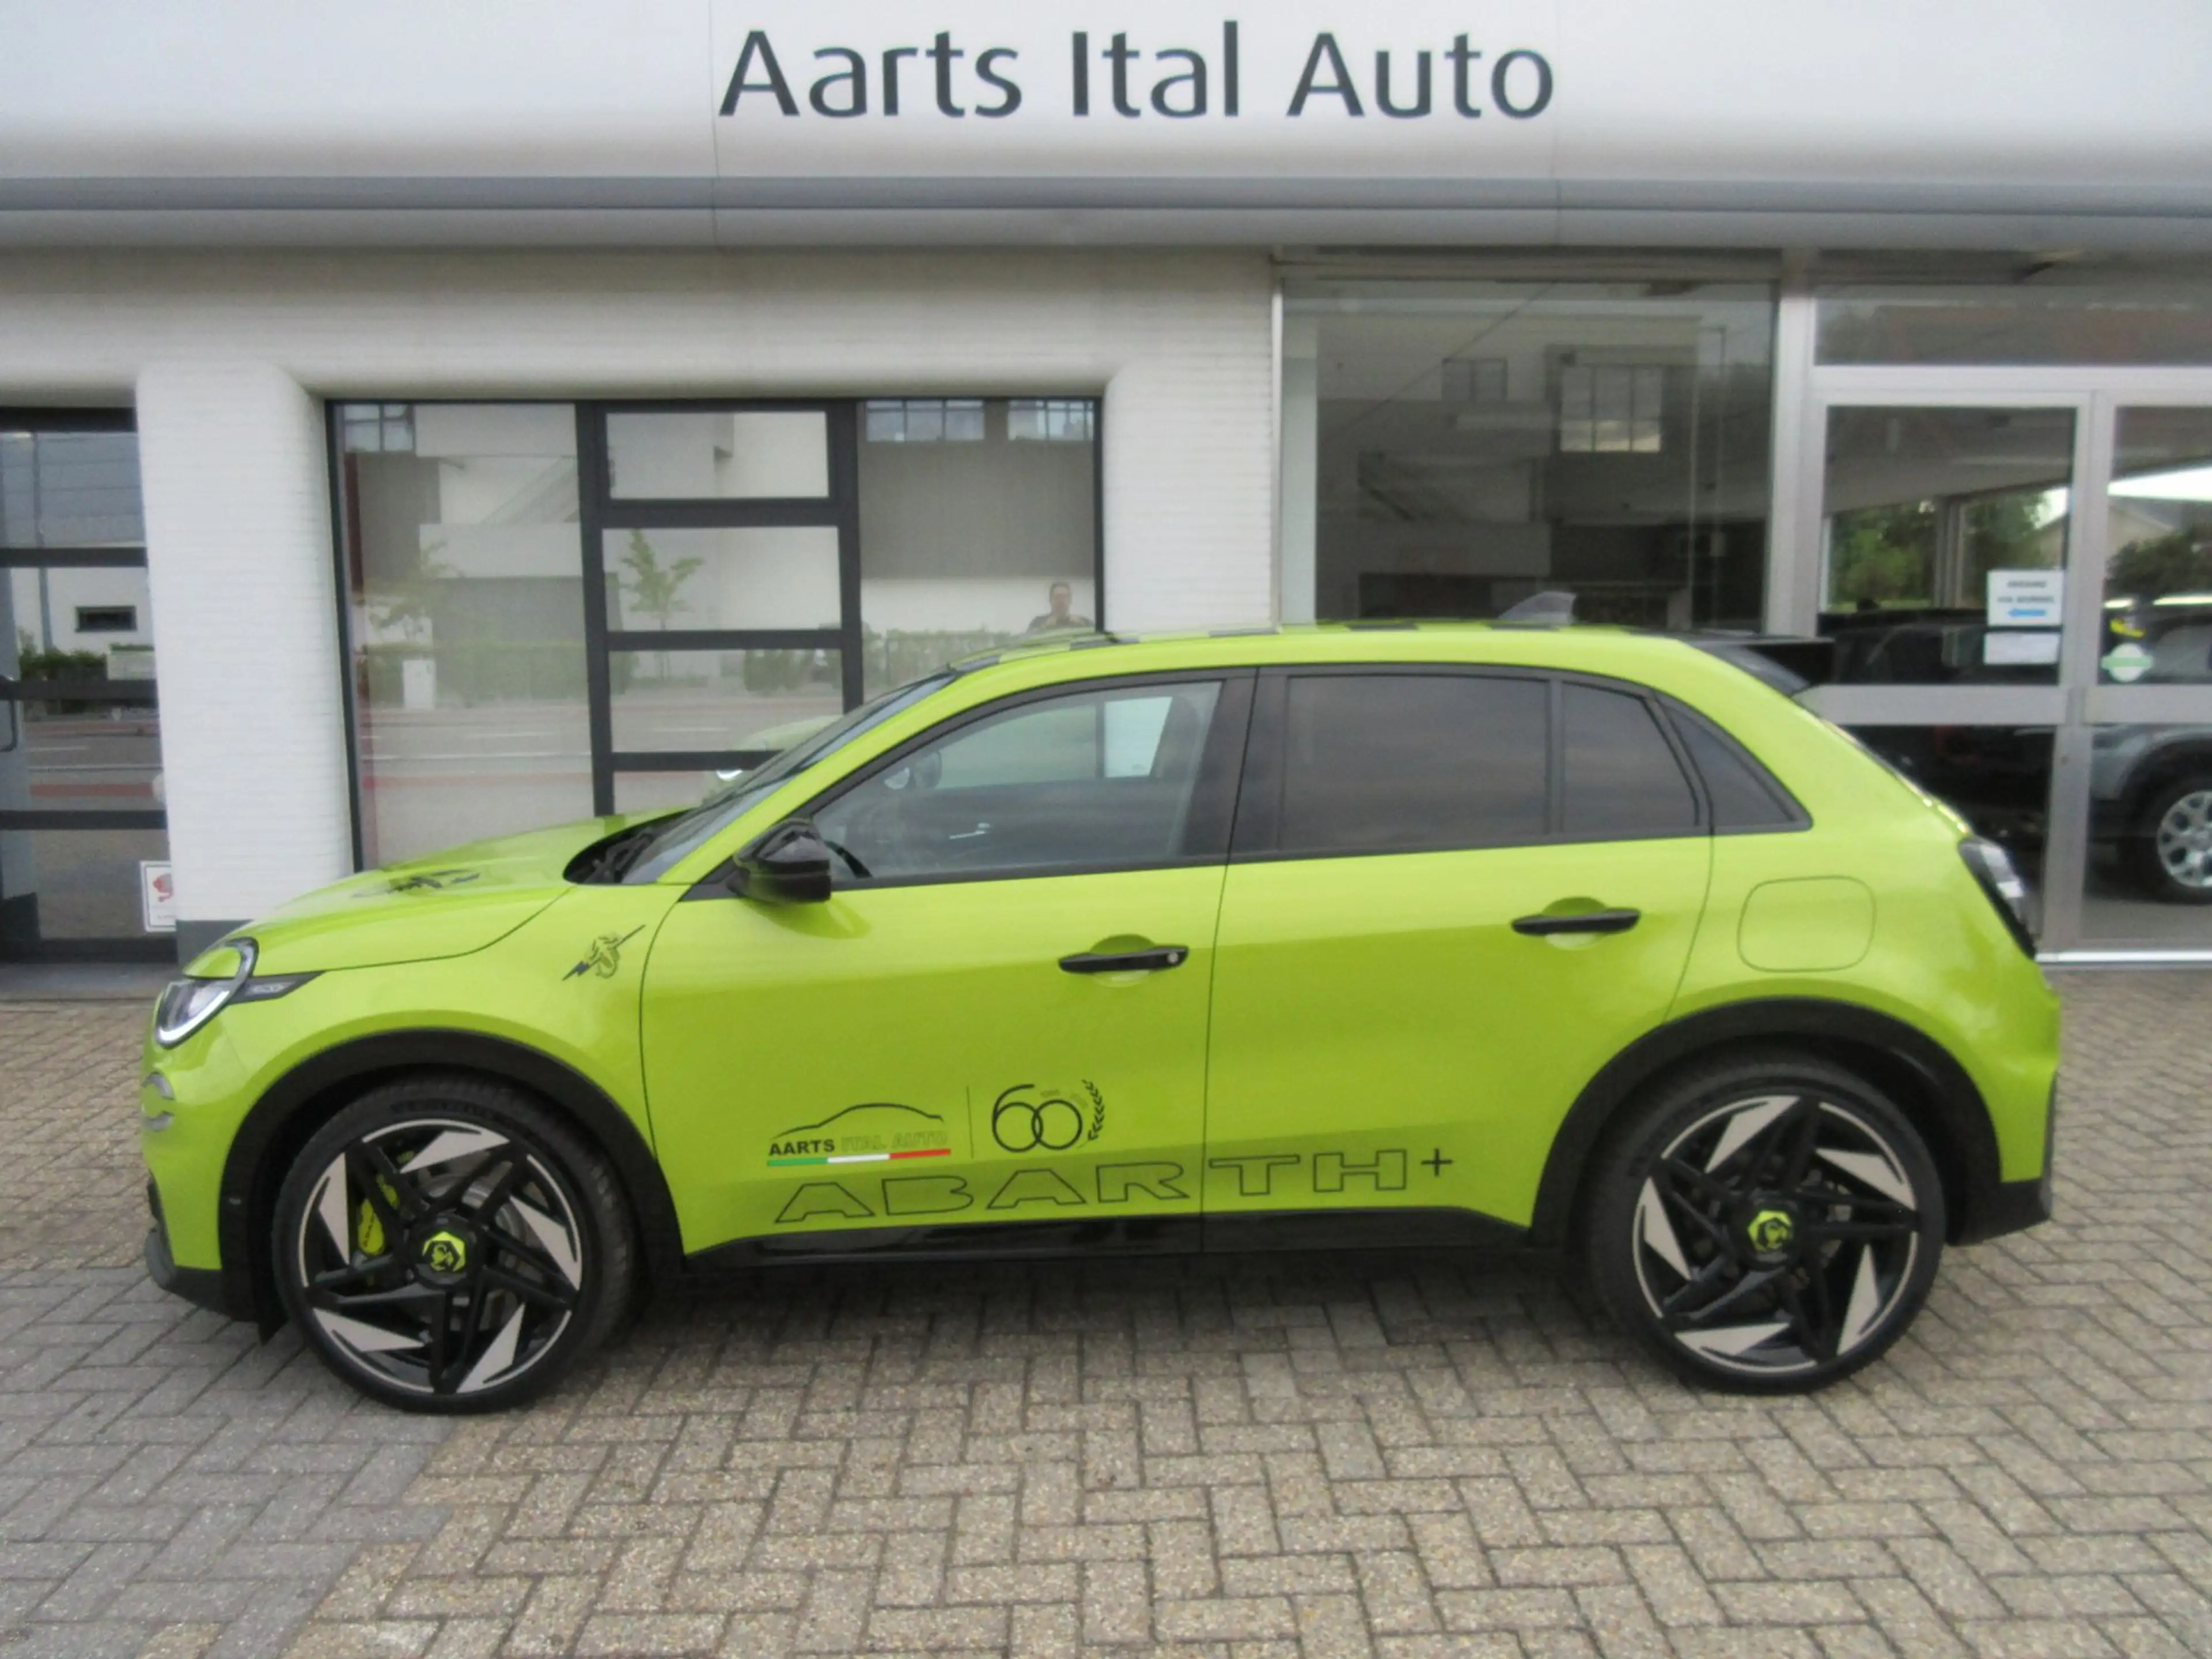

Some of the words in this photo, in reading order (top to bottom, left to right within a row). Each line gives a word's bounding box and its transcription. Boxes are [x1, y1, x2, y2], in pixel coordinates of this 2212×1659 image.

[719, 29, 1023, 118] Aarts
[1070, 20, 1240, 118] Ital
[1285, 30, 1555, 118] Auto
[769, 1139, 835, 1156] AARTS
